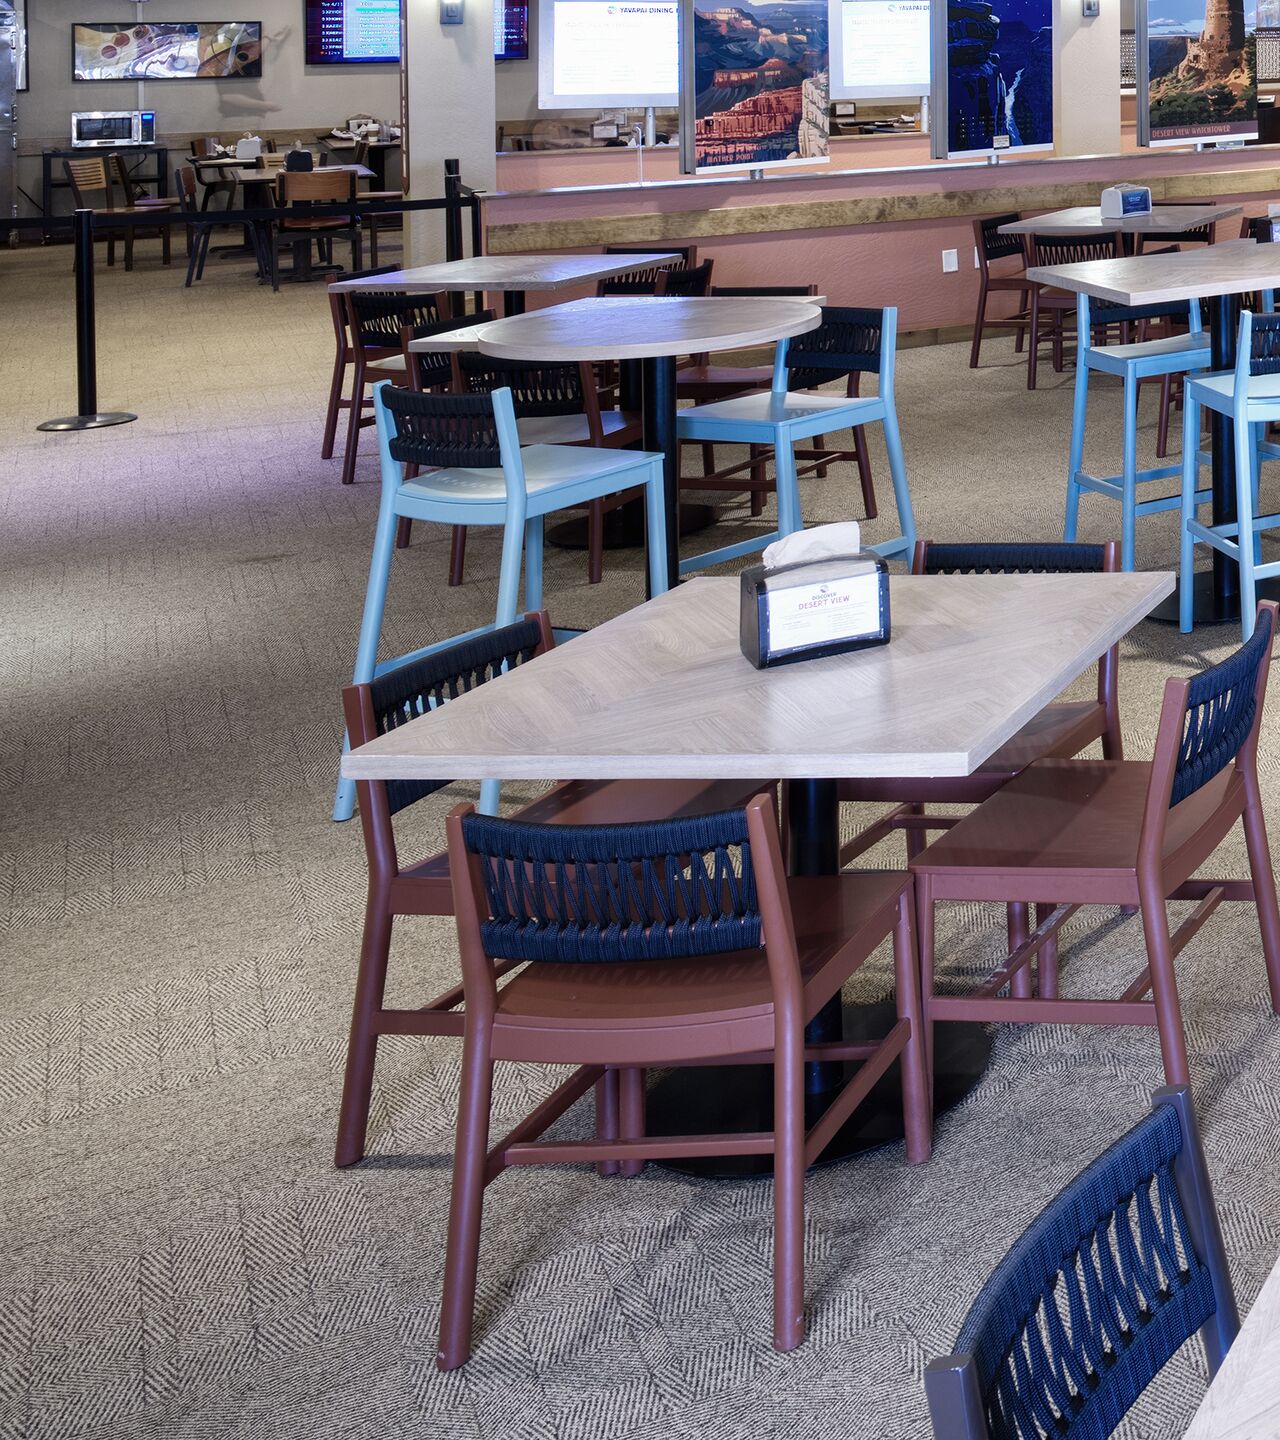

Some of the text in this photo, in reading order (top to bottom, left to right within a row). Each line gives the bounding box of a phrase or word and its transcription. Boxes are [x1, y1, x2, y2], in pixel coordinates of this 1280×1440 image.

[1152, 128, 1174, 138] DESERT
[1176, 127, 1190, 136] VIEW
[811, 591, 837, 601] DISCOVER
[798, 595, 851, 610] DESERT VIEW
